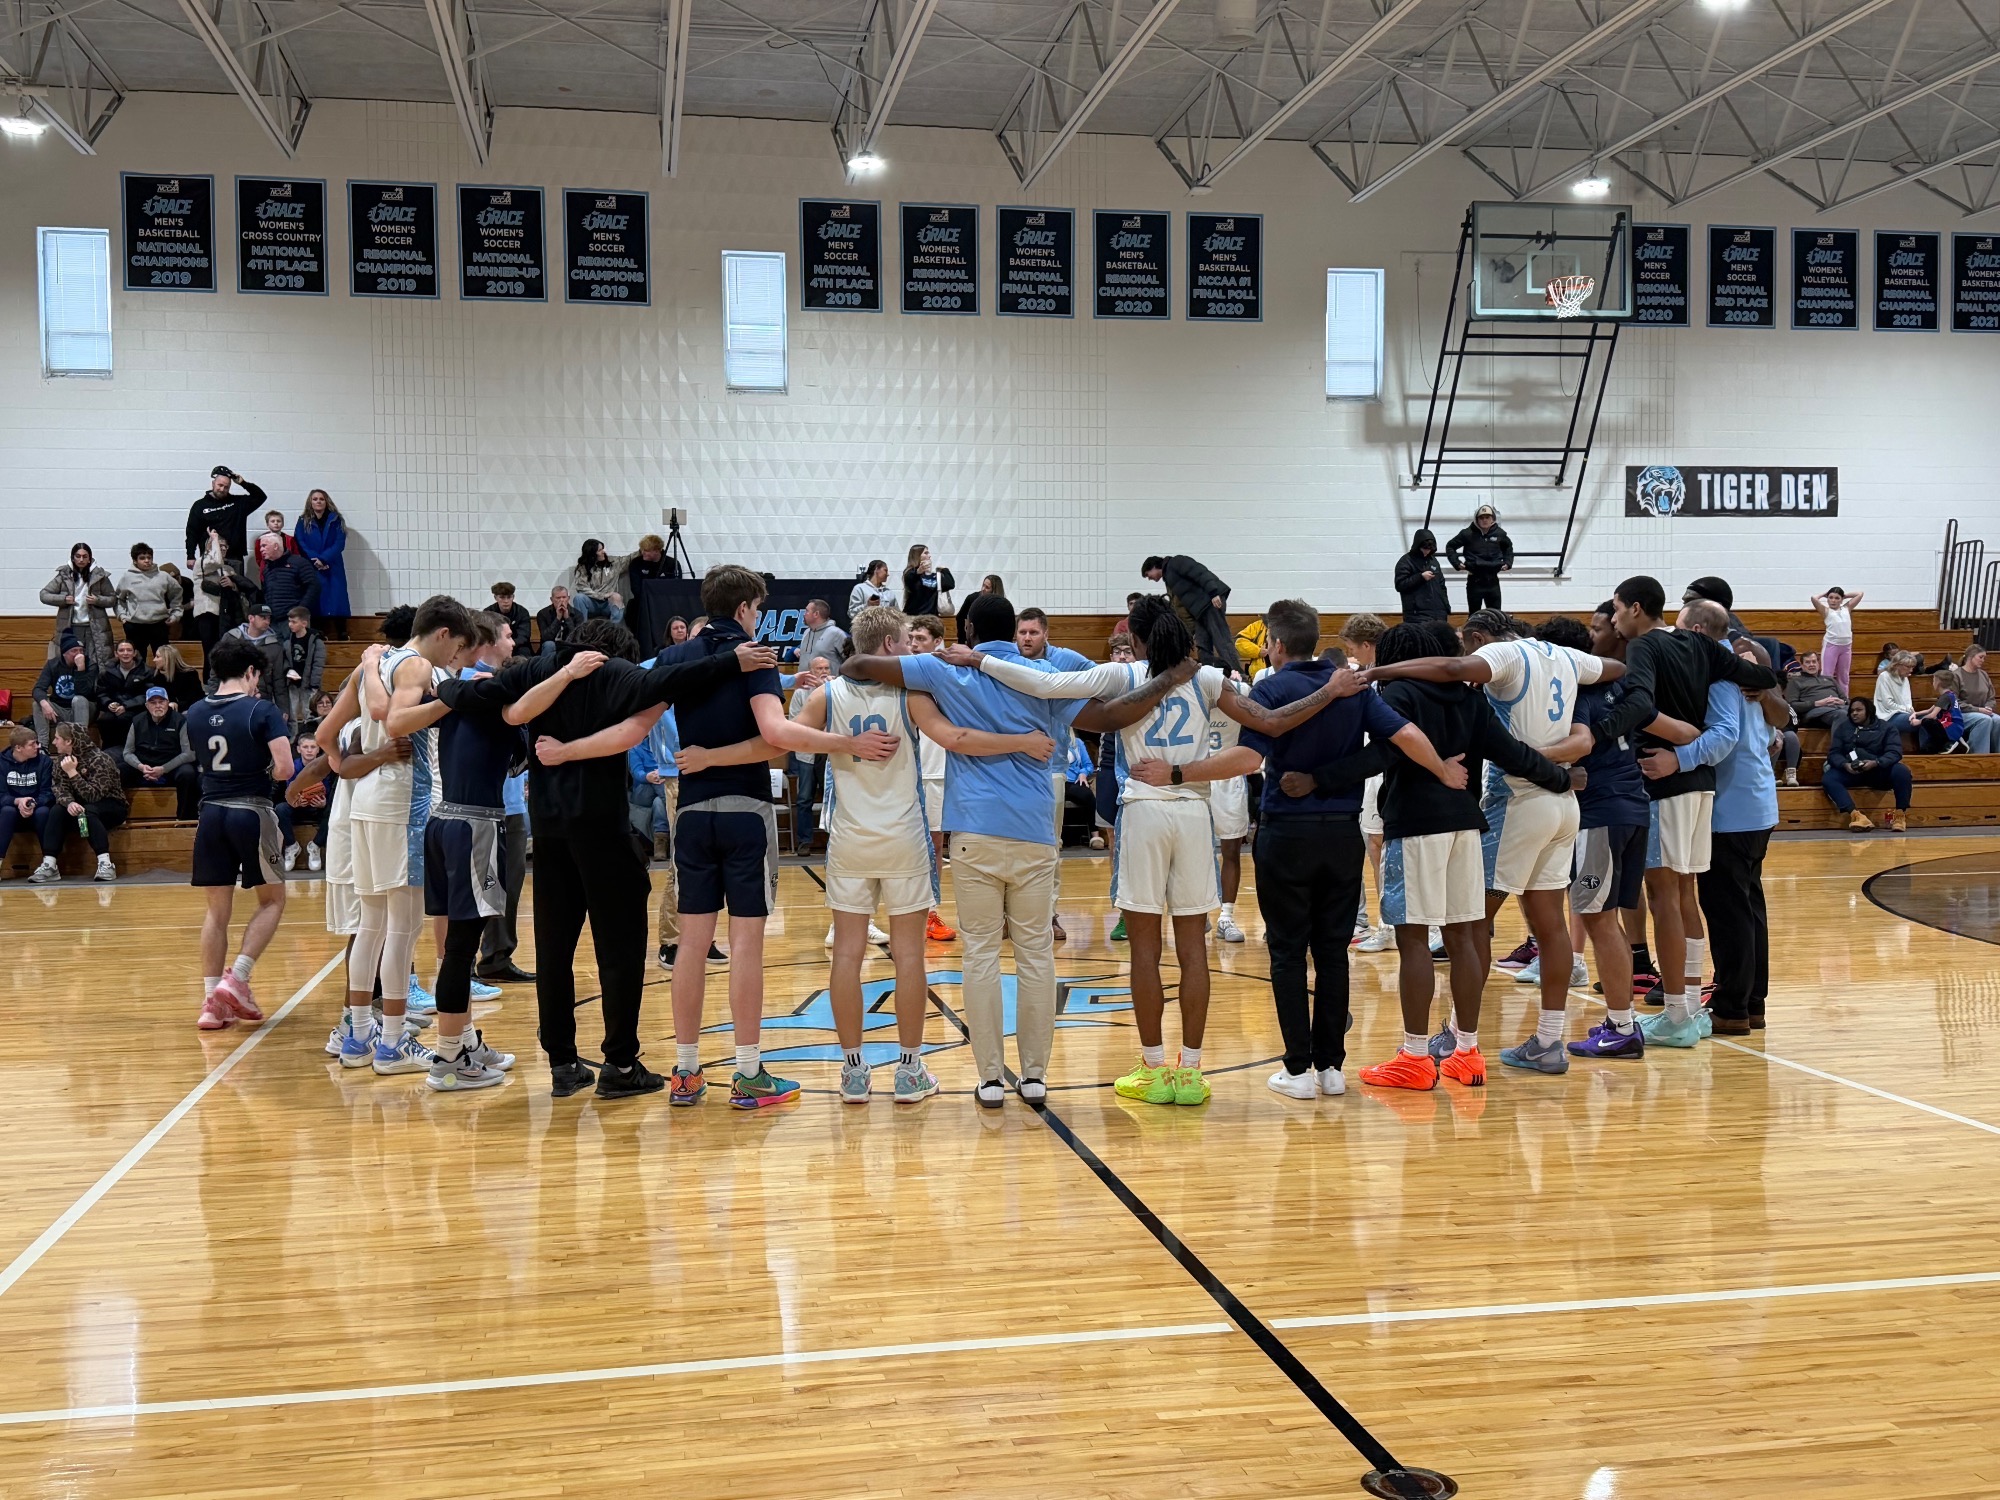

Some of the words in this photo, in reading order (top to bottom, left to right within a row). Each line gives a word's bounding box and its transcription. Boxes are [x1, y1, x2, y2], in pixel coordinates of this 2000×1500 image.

[142, 196, 193, 216] GRACE
[255, 199, 305, 219] GRACE
[367, 204, 417, 223] GRACE
[476, 207, 525, 226] GRACE
[154, 218, 183, 226] MEN'S
[259, 221, 304, 230] WOMEN'S
[581, 211, 629, 230] GRACE
[139, 229, 200, 238] BASKETBALL
[371, 224, 416, 234] WOMEN'S
[480, 228, 524, 237] WOMEN'S
[817, 221, 862, 239] GRACE
[917, 225, 961, 243] GRACE
[242, 232, 274, 241] CROSS
[276, 233, 321, 242] COUNTRY
[375, 236, 412, 245] SOCCER
[593, 232, 620, 241] MEN'S
[1013, 227, 1057, 245] GRACE
[1110, 230, 1152, 249] GRACE
[484, 239, 520, 249] SOCCER
[1203, 233, 1245, 251] GRACE
[137, 242, 203, 254] NATIONAL
[252, 246, 314, 258] NATIONAL
[589, 243, 624, 253] SOCCER
[920, 245, 960, 253] WOMEN'S
[1016, 248, 1055, 256] WOMEN'S
[1635, 243, 1674, 261] GRACE
[1722, 245, 1760, 262] GRACE
[364, 249, 426, 261] REGIONAL
[473, 253, 534, 264] NATIONAL
[824, 252, 858, 260] SOCCER
[913, 256, 966, 265] BASKETBALL
[1120, 251, 1144, 259] MEN'S
[1213, 254, 1236, 262] MEN'S
[1806, 247, 1844, 264] GRACE
[1888, 250, 1926, 267] GRACE
[131, 256, 208, 268] CHAMPIONS
[247, 260, 273, 270] 4TH
[276, 260, 318, 272] PLACE
[577, 256, 638, 268] REGIONAL
[1009, 258, 1062, 268] BASKETBALL
[1106, 261, 1158, 270] BASKETBALL
[1644, 262, 1667, 270] MEN'S
[356, 261, 433, 275] CHAMPIONS
[467, 266, 540, 279] RUNNER-UP
[814, 265, 870, 276] NATIONAL
[1199, 264, 1250, 272] BASKETBALL
[151, 271, 191, 285] 2019
[571, 269, 645, 283] CHAMPIONS
[913, 269, 968, 279] REGIONAL
[1009, 271, 1063, 282] NATIONAL
[1105, 274, 1159, 285] REGIONAL
[1640, 272, 1670, 280] SOCCER
[1727, 274, 1756, 282] SOCCER
[264, 275, 304, 288] 2019
[377, 278, 416, 291] 2019
[810, 278, 833, 288] 4TH
[836, 279, 873, 289] PLACE
[1198, 276, 1236, 286] NCCAA
[1239, 276, 1251, 287] #1
[1803, 276, 1848, 284] VOLLEYBALL
[1885, 278, 1930, 286] BASKETBALL
[1962, 280, 2000, 288] BASKETBA
[486, 281, 524, 294] 2019
[591, 285, 629, 298] 2019
[906, 281, 974, 293] CHAMPIONS
[1002, 283, 1035, 295] FINAL
[1038, 285, 1069, 296] FOUR
[1099, 287, 1165, 298] CHAMPIONS
[1637, 283, 1681, 294] EGIONAL
[1717, 285, 1767, 295] NATIONAL
[1801, 287, 1851, 297] REGIONAL
[826, 292, 861, 305] 2019
[1193, 288, 1226, 299] FINAL
[1228, 289, 1256, 300] POLL
[1883, 289, 1932, 299] REGIONAL
[1961, 291, 2000, 300] NATIONA
[923, 296, 961, 308] 2020
[1018, 298, 1056, 311] 2020
[1637, 296, 1685, 306] AMPIONS
[1715, 297, 1735, 307] 3RD
[1737, 297, 1768, 308] PLACE
[1797, 300, 1854, 310] CHAMPIONS
[1115, 301, 1152, 313] 2020
[1207, 302, 1244, 315] 2020
[1879, 302, 1935, 312] CHAMPIONS
[1957, 303, 1984, 312] FINAL
[1986, 304, 2000, 313] FO
[1638, 309, 1673, 321] 2020
[1725, 311, 1759, 322] 2020
[1810, 313, 1842, 324] 2020
[1893, 315, 1922, 326] 2021
[1970, 316, 1999, 327] 2021
[1697, 473, 1769, 510] TIGER
[1780, 473, 1828, 510] DEN
[1548, 676, 1565, 722] 3
[1145, 696, 1194, 747] 22
[207, 735, 232, 771] 2
